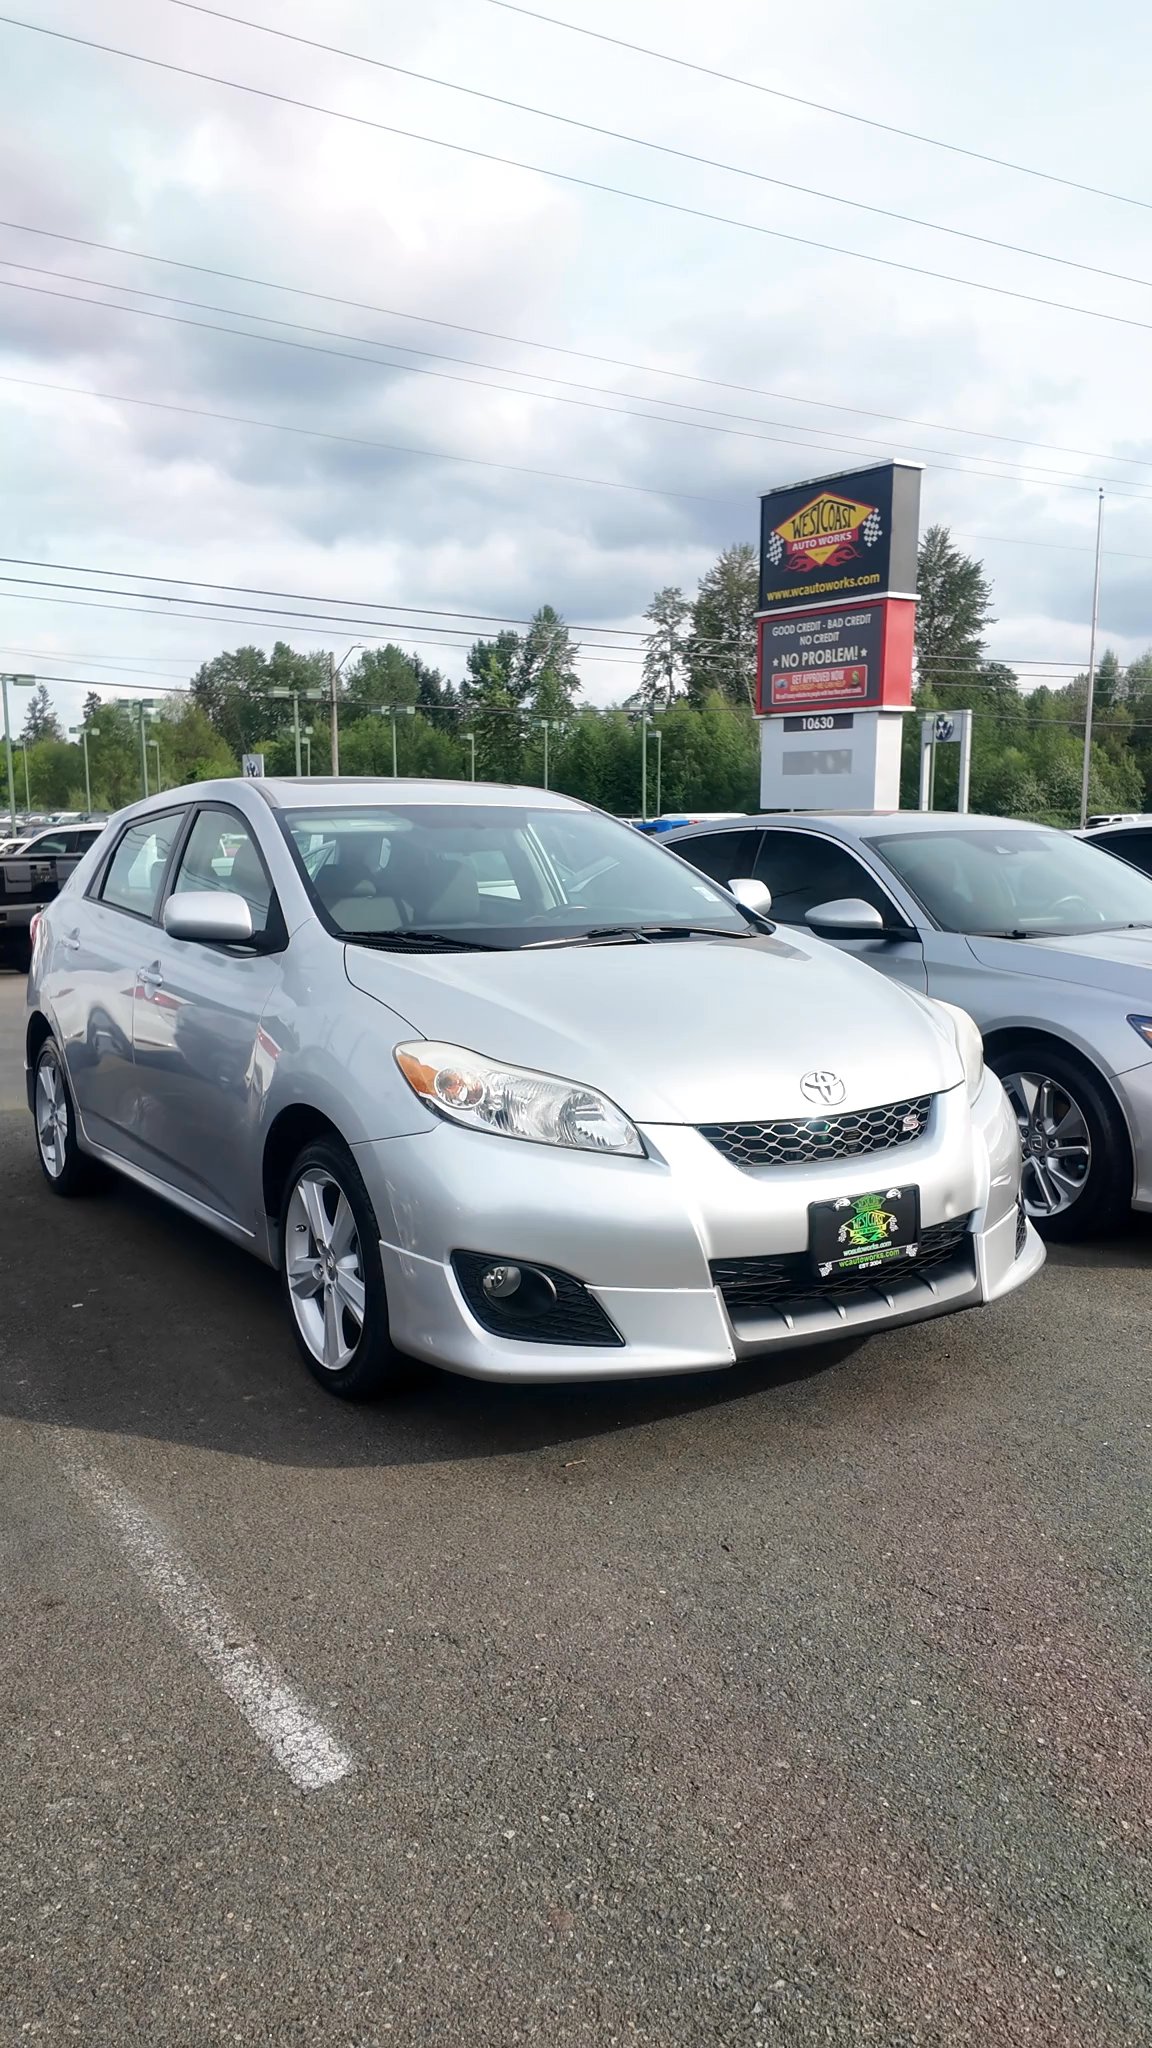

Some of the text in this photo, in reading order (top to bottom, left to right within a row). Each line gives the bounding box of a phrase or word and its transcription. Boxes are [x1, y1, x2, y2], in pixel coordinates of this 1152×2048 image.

[792, 532, 852, 551] AUTO WORKS
[767, 573, 880, 600] www.wcautoworks.com
[772, 625, 795, 636] GOOD
[796, 621, 821, 633] CREDIT
[827, 618, 843, 629] BAD
[844, 613, 872, 627] CREDIT
[800, 631, 840, 646] NO CREDIT
[781, 645, 858, 668] NO PROBLEM!
[801, 717, 834, 731] 10630
[839, 1249, 900, 1268] wcautoworks.com
